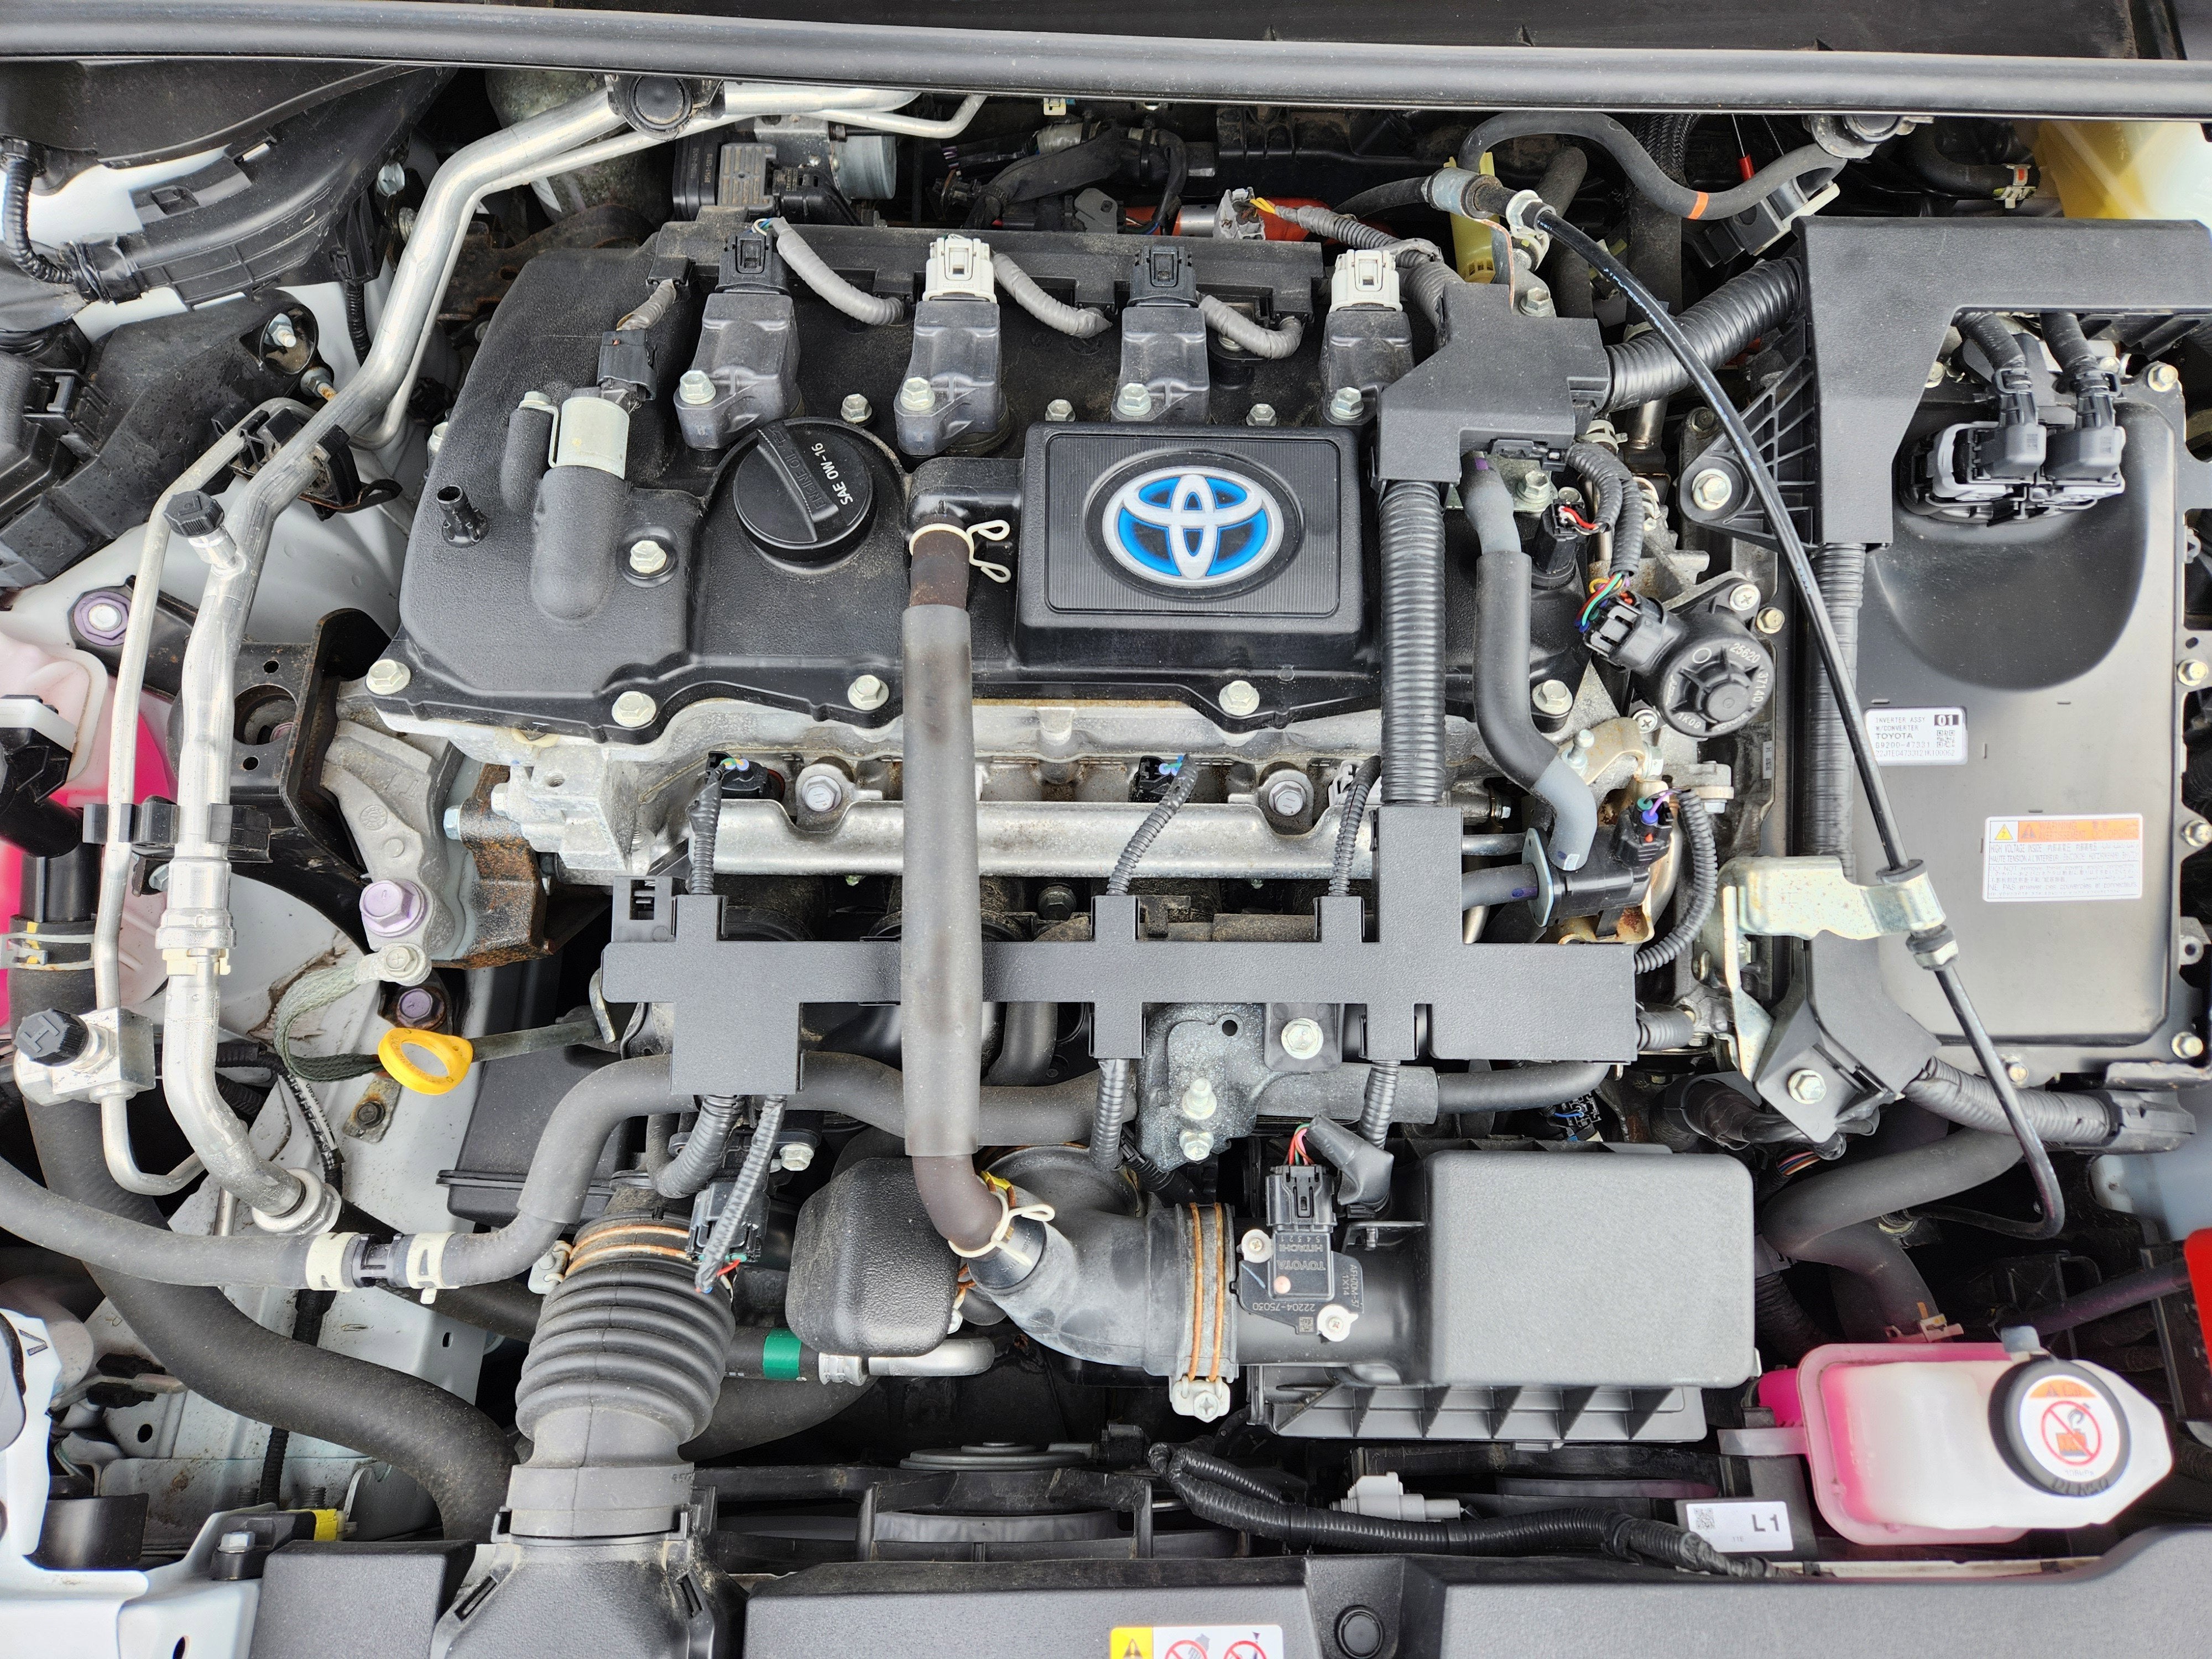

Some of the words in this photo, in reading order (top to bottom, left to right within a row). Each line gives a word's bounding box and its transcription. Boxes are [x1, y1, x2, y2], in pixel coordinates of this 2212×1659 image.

[785, 453, 801, 468] OIL
[811, 442, 839, 479] 0W-16
[794, 471, 826, 509] ENGINE
[832, 481, 853, 505] SAE
[1729, 643, 1761, 663] 25620
[1752, 670, 1768, 702] 37140
[1937, 715, 1954, 726] 01
[1991, 844, 2002, 853] HIGH
[2005, 844, 2025, 853] VOLTAGE
[2028, 844, 2042, 852] INSIDE
[1277, 1260, 1326, 1270] TOYOTA
[1350, 1264, 1360, 1308] AFH70M-37
[1253, 1302, 1316, 1312] 22204-75030
[1751, 1514, 1780, 1532] L1
